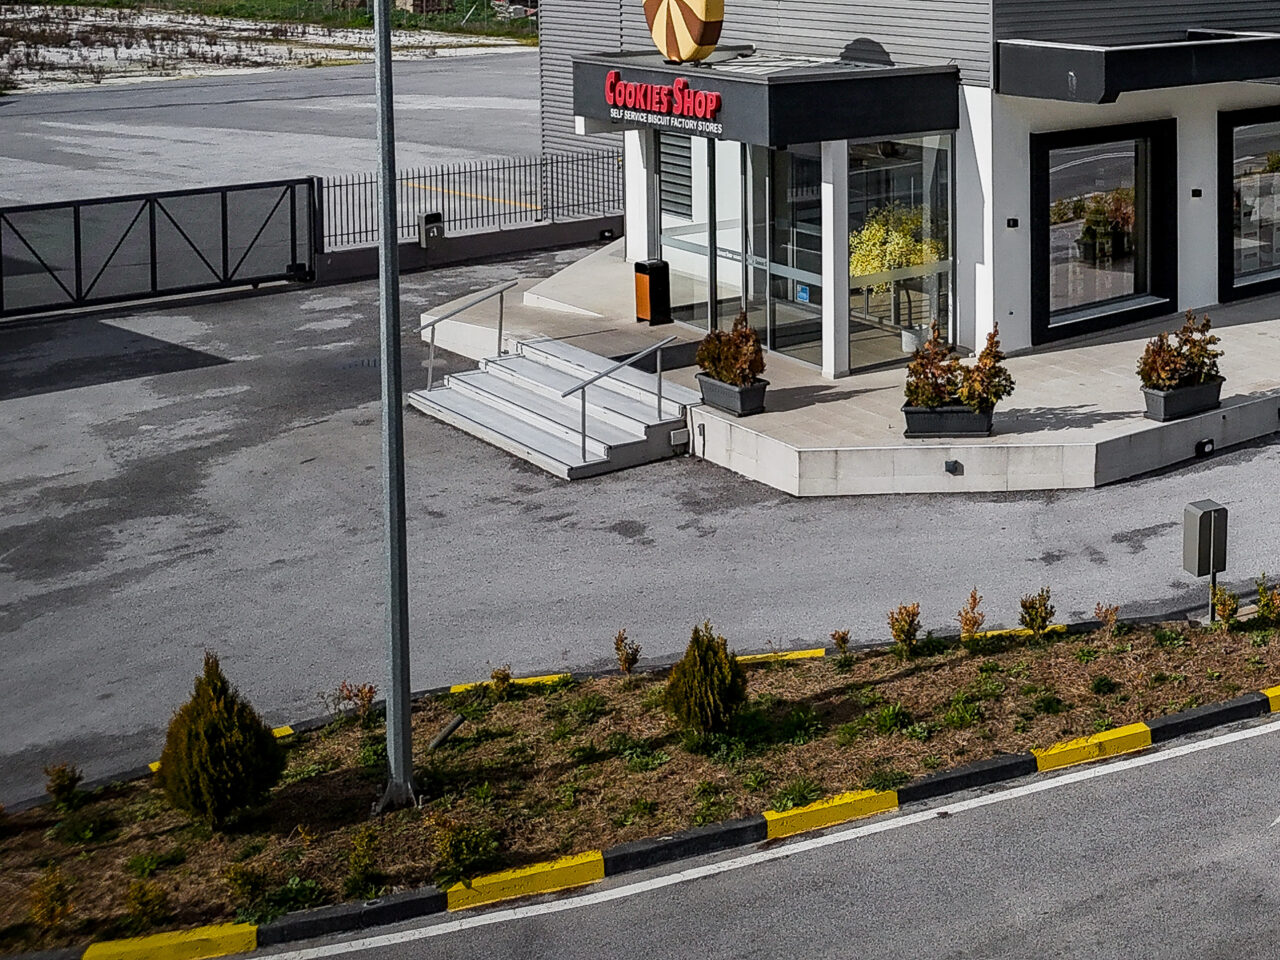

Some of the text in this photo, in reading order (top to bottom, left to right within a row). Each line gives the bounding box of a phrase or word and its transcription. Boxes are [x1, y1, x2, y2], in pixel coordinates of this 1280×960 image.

[610, 108, 723, 134] SELF SERVICE BISCUIT FACTORY STORES
